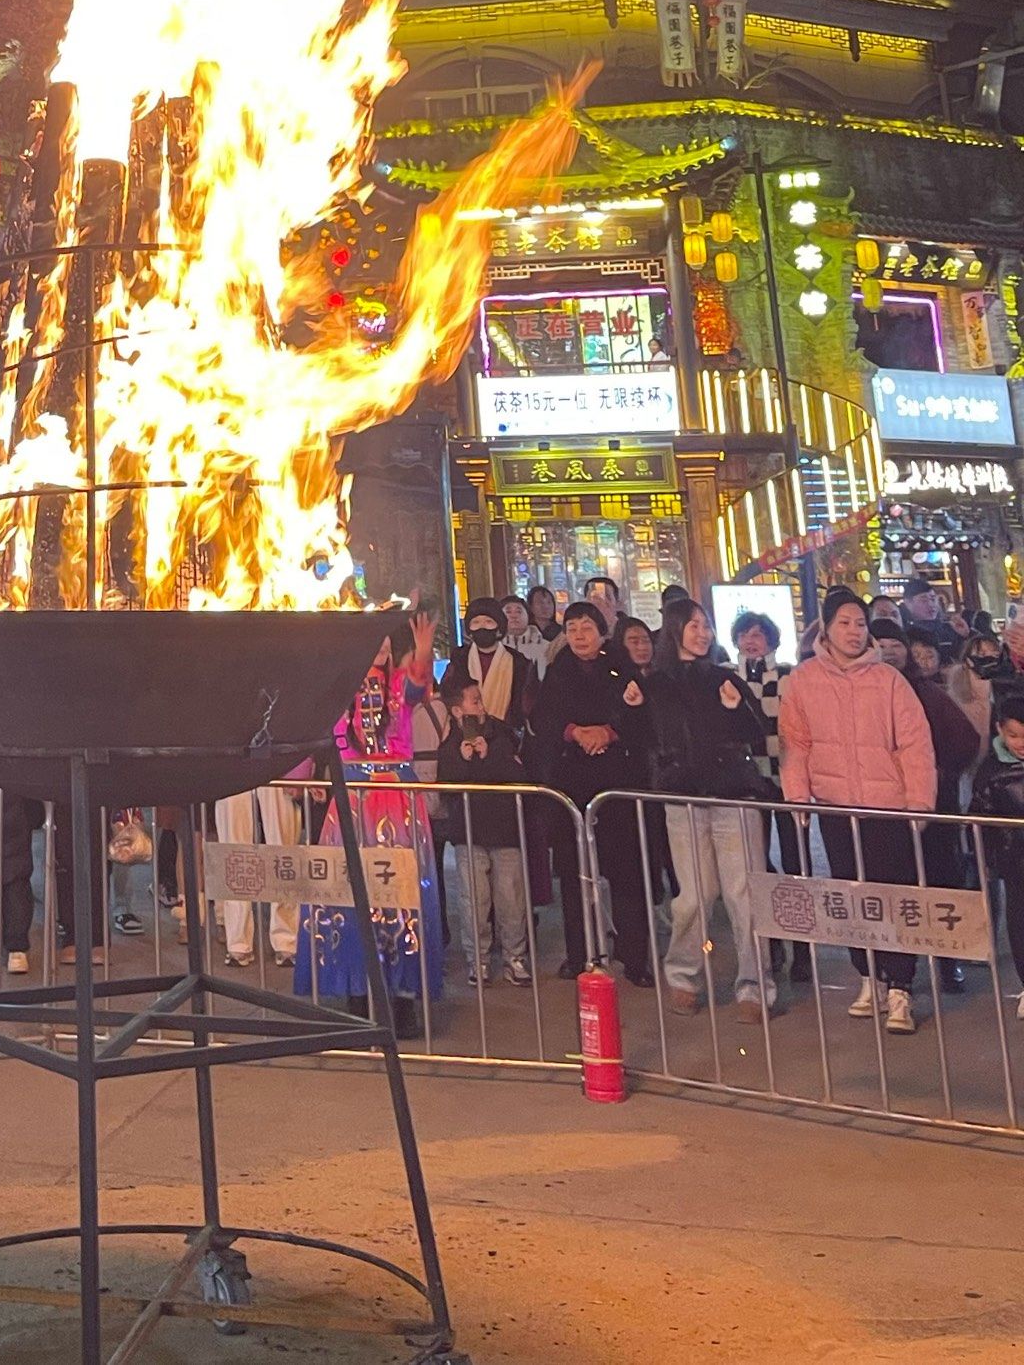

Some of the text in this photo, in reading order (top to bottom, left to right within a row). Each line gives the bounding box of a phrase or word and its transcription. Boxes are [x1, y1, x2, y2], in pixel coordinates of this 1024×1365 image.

[514, 309, 640, 340] 正在营业
[274, 856, 396, 885] 福园子
[822, 891, 962, 931] 福园巷子
